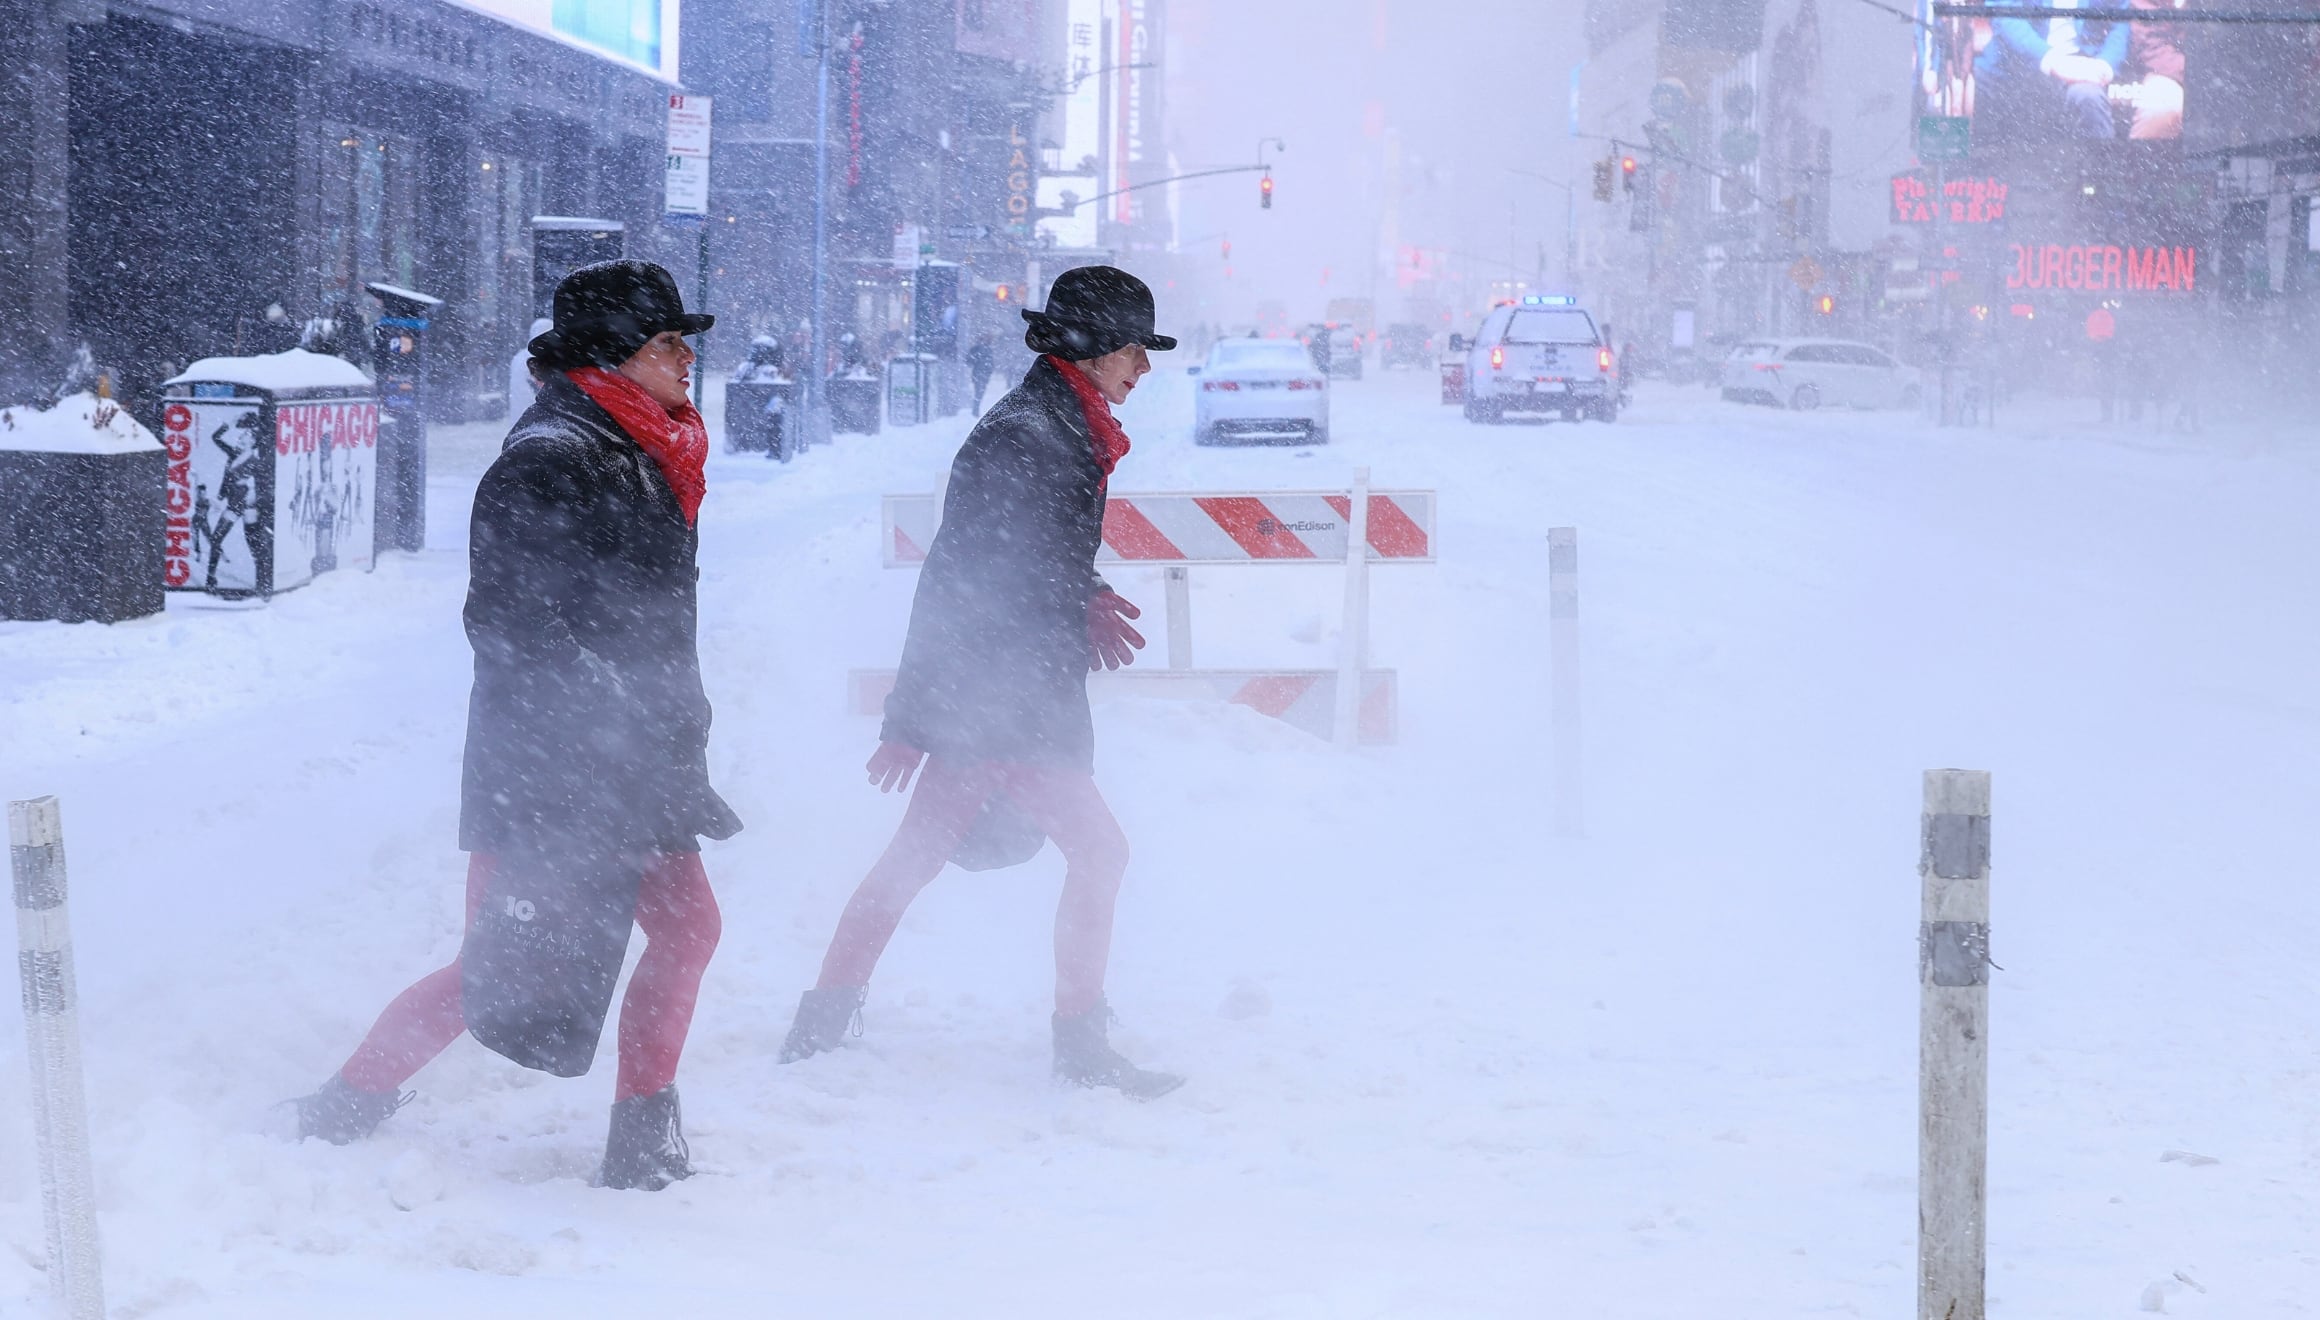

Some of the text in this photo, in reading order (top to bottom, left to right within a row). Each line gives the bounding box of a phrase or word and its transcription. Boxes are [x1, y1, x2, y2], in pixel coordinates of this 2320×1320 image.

[1892, 176, 2008, 205] Plawright
[2127, 245, 2195, 291] MAN
[275, 404, 378, 456] CHICAGO
[164, 404, 192, 586] CHICAGO
